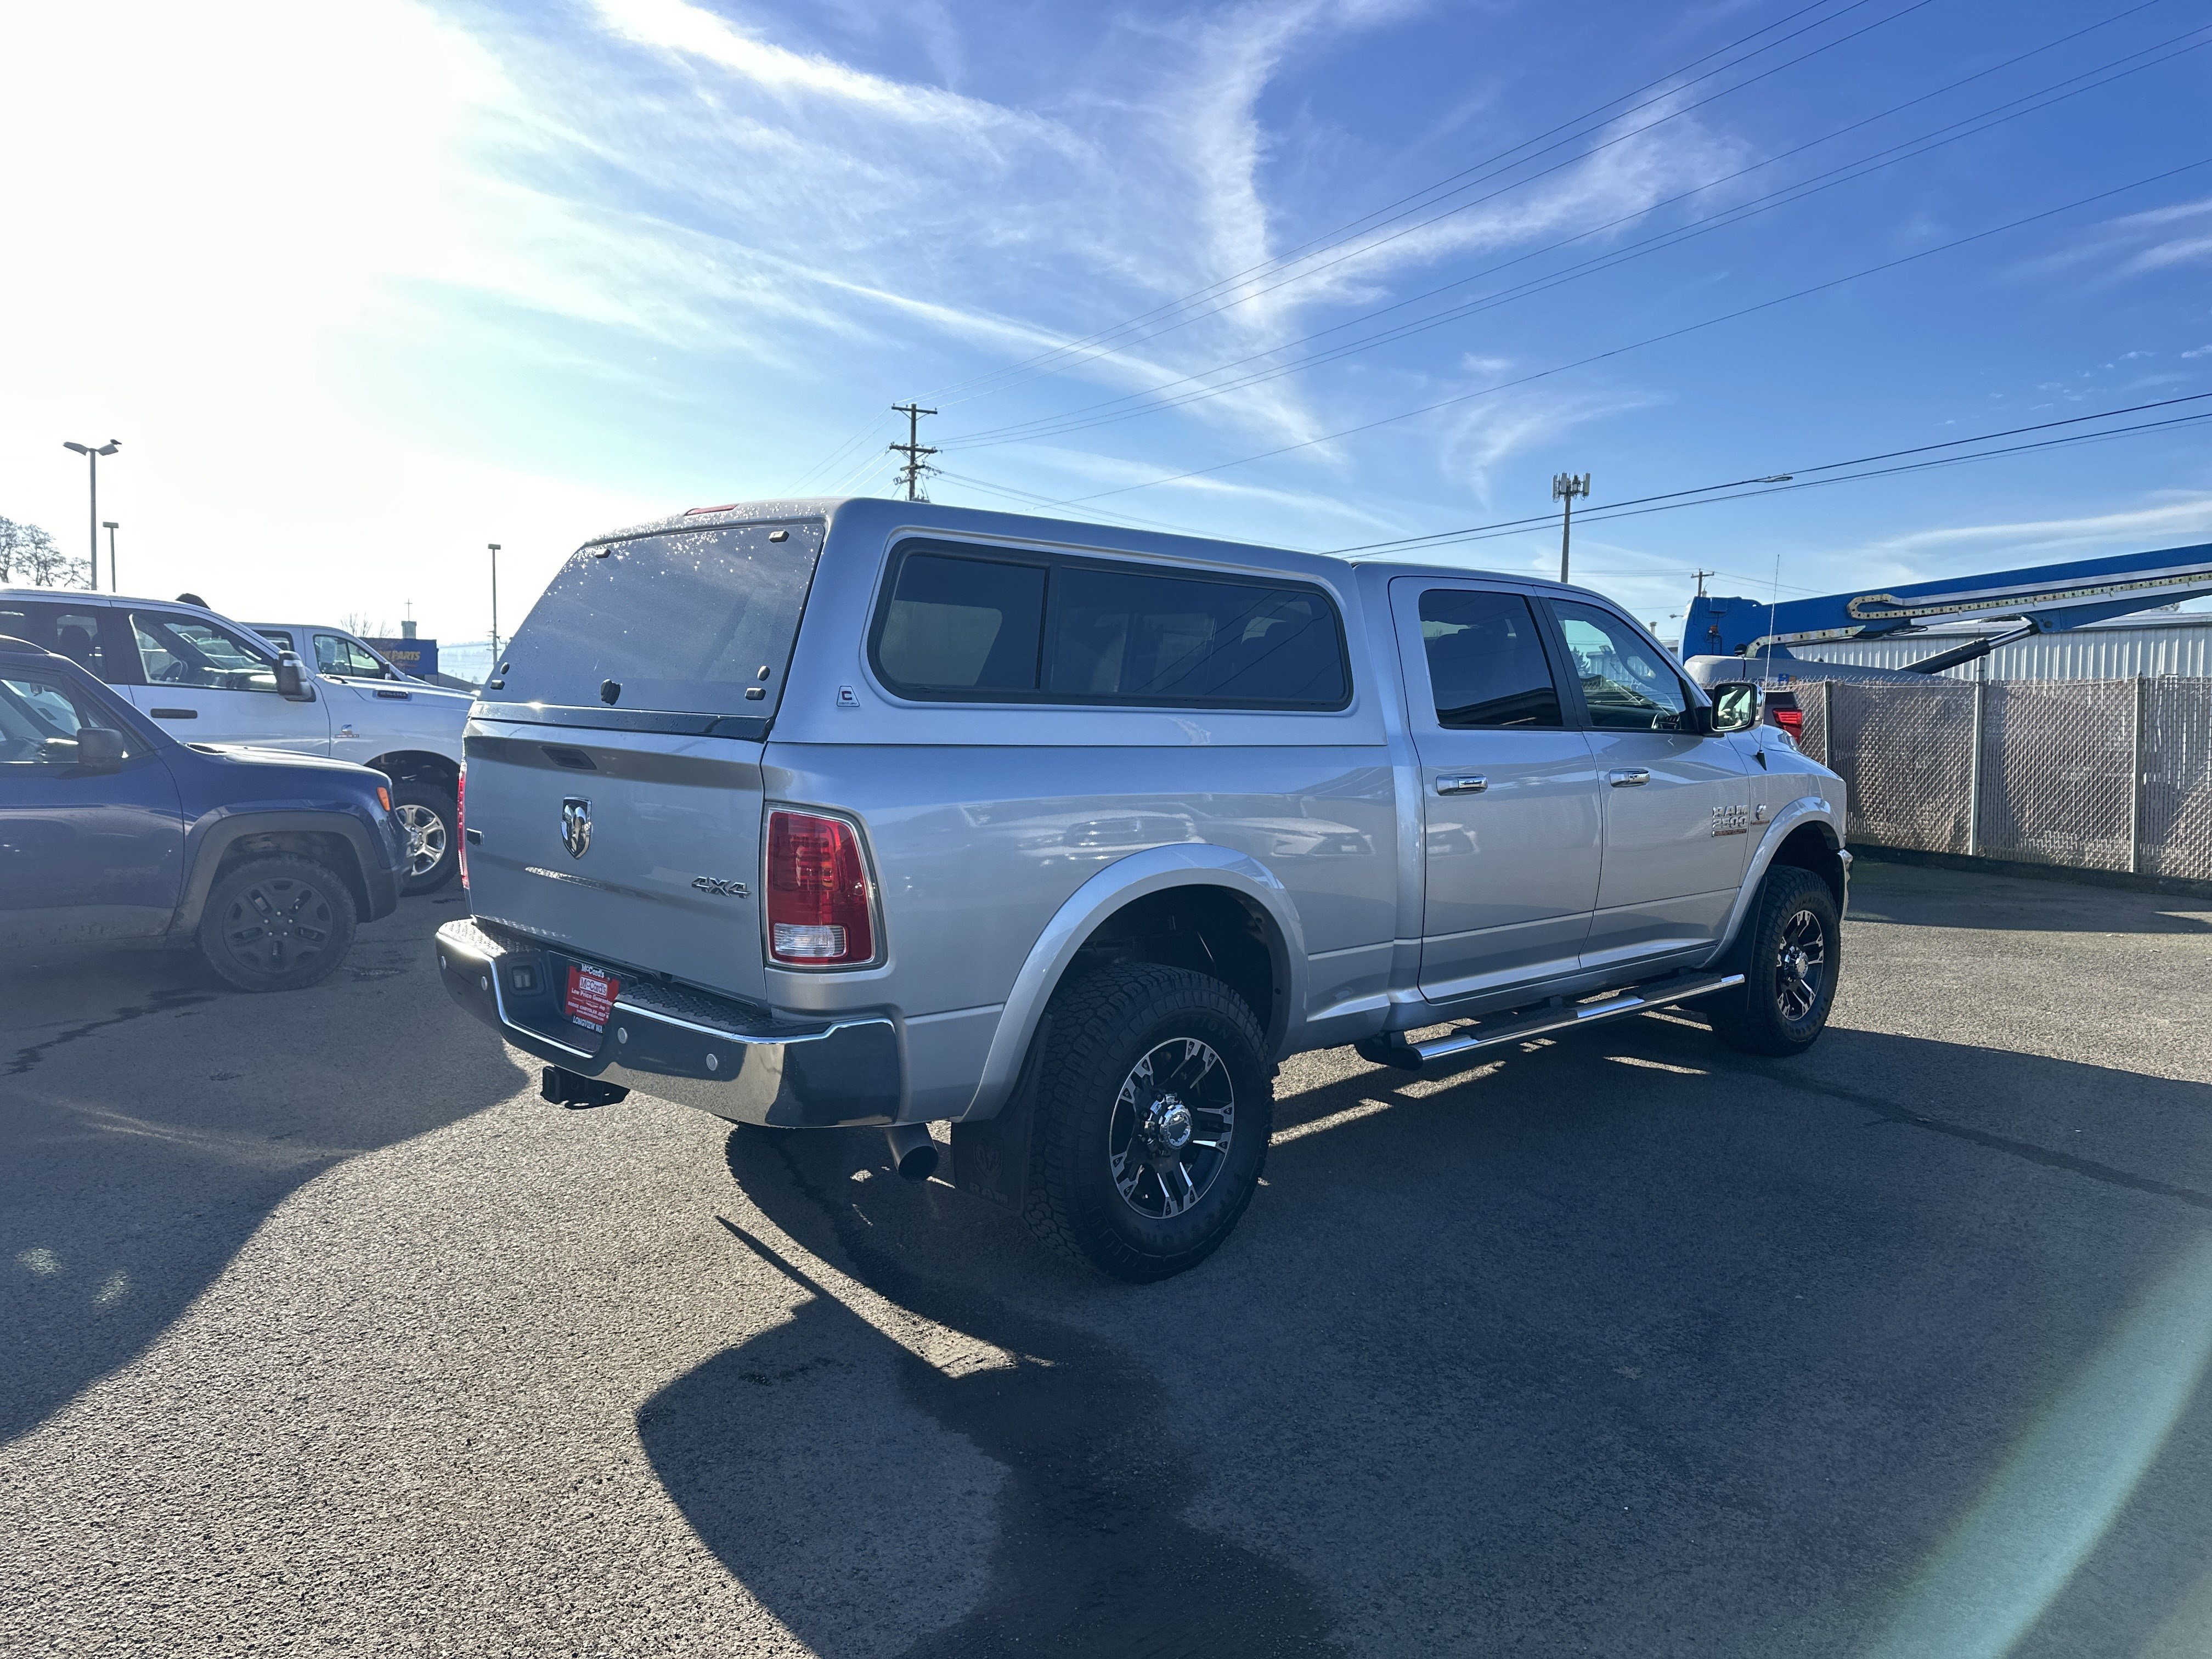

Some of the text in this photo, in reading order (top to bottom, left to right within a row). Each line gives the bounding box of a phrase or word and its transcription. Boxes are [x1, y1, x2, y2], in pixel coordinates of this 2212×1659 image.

[392, 650, 420, 662] PARTS
[1712, 805, 1748, 818] RAM
[1712, 816, 1747, 828] 2500
[580, 978, 606, 994] McCord's
[580, 990, 592, 999] Price
[573, 1016, 603, 1034] LONGVIEW WA
